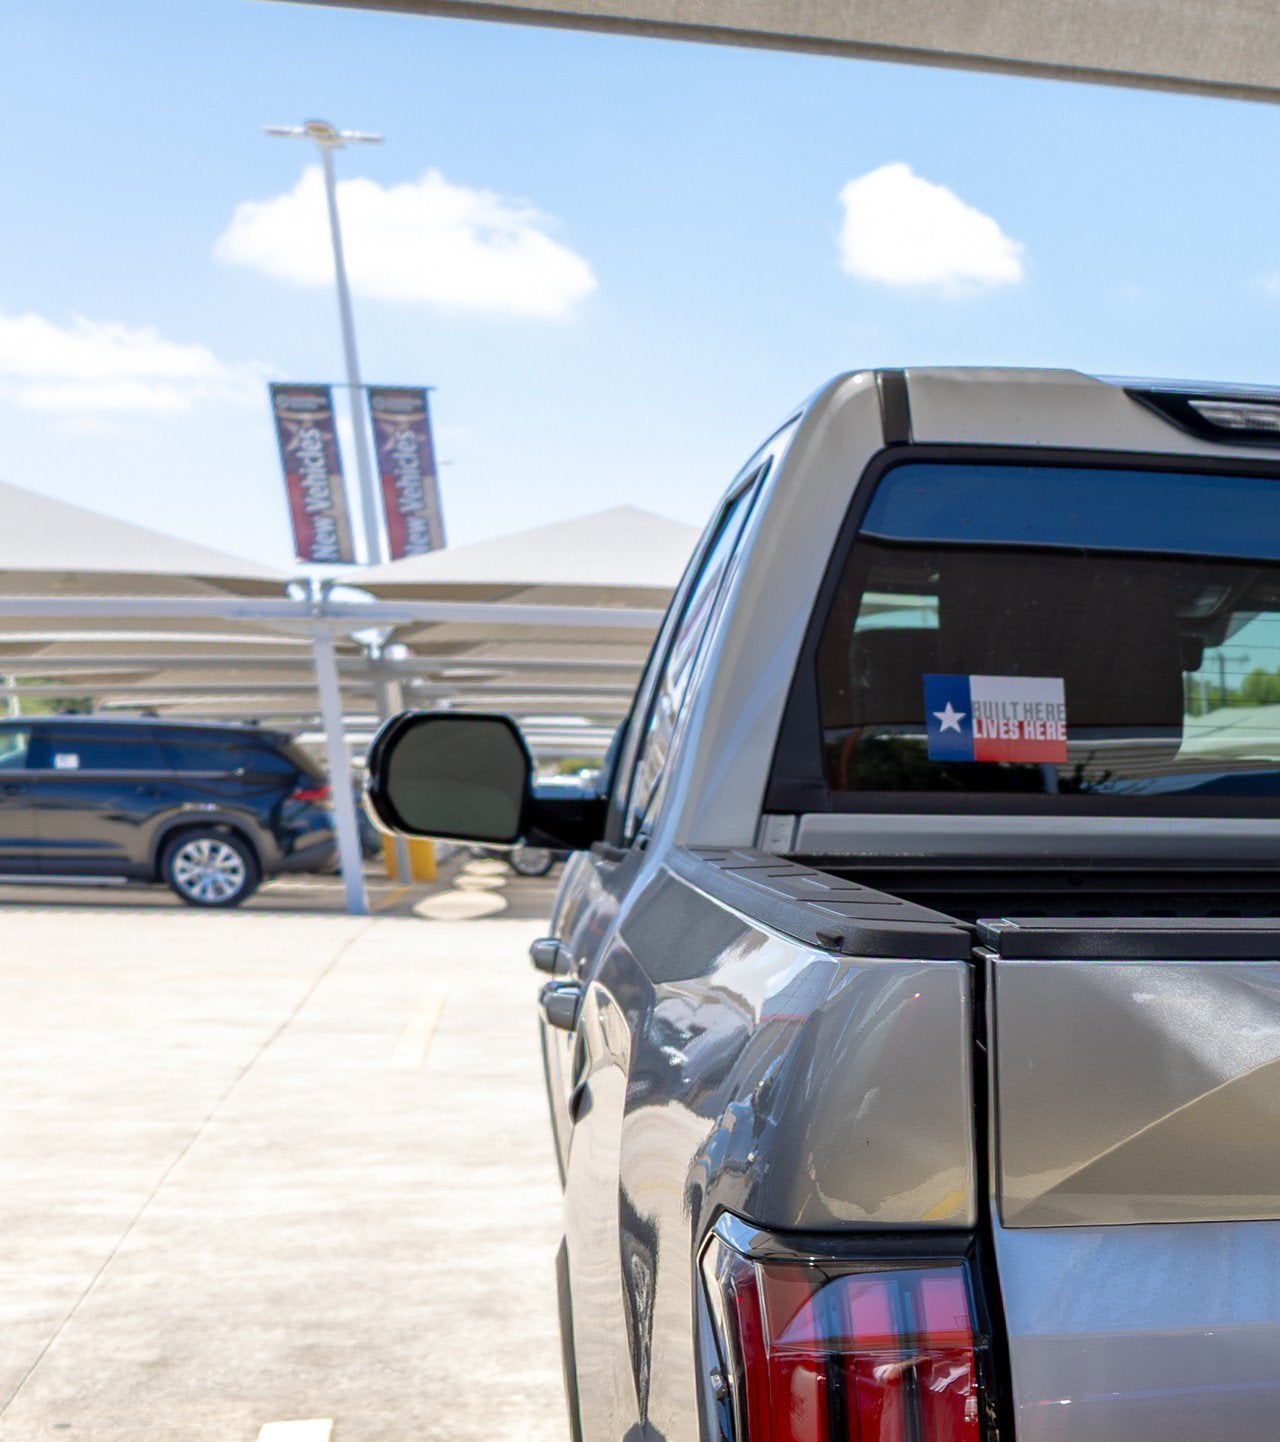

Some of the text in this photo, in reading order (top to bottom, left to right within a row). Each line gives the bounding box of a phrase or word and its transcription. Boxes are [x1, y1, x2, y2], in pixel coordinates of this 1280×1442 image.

[296, 427, 333, 514] Vehicles
[394, 429, 426, 514] Vehicles
[310, 514, 340, 561] New
[972, 700, 1065, 722] BUILT HERE
[973, 719, 1067, 741] LIVES HERE
